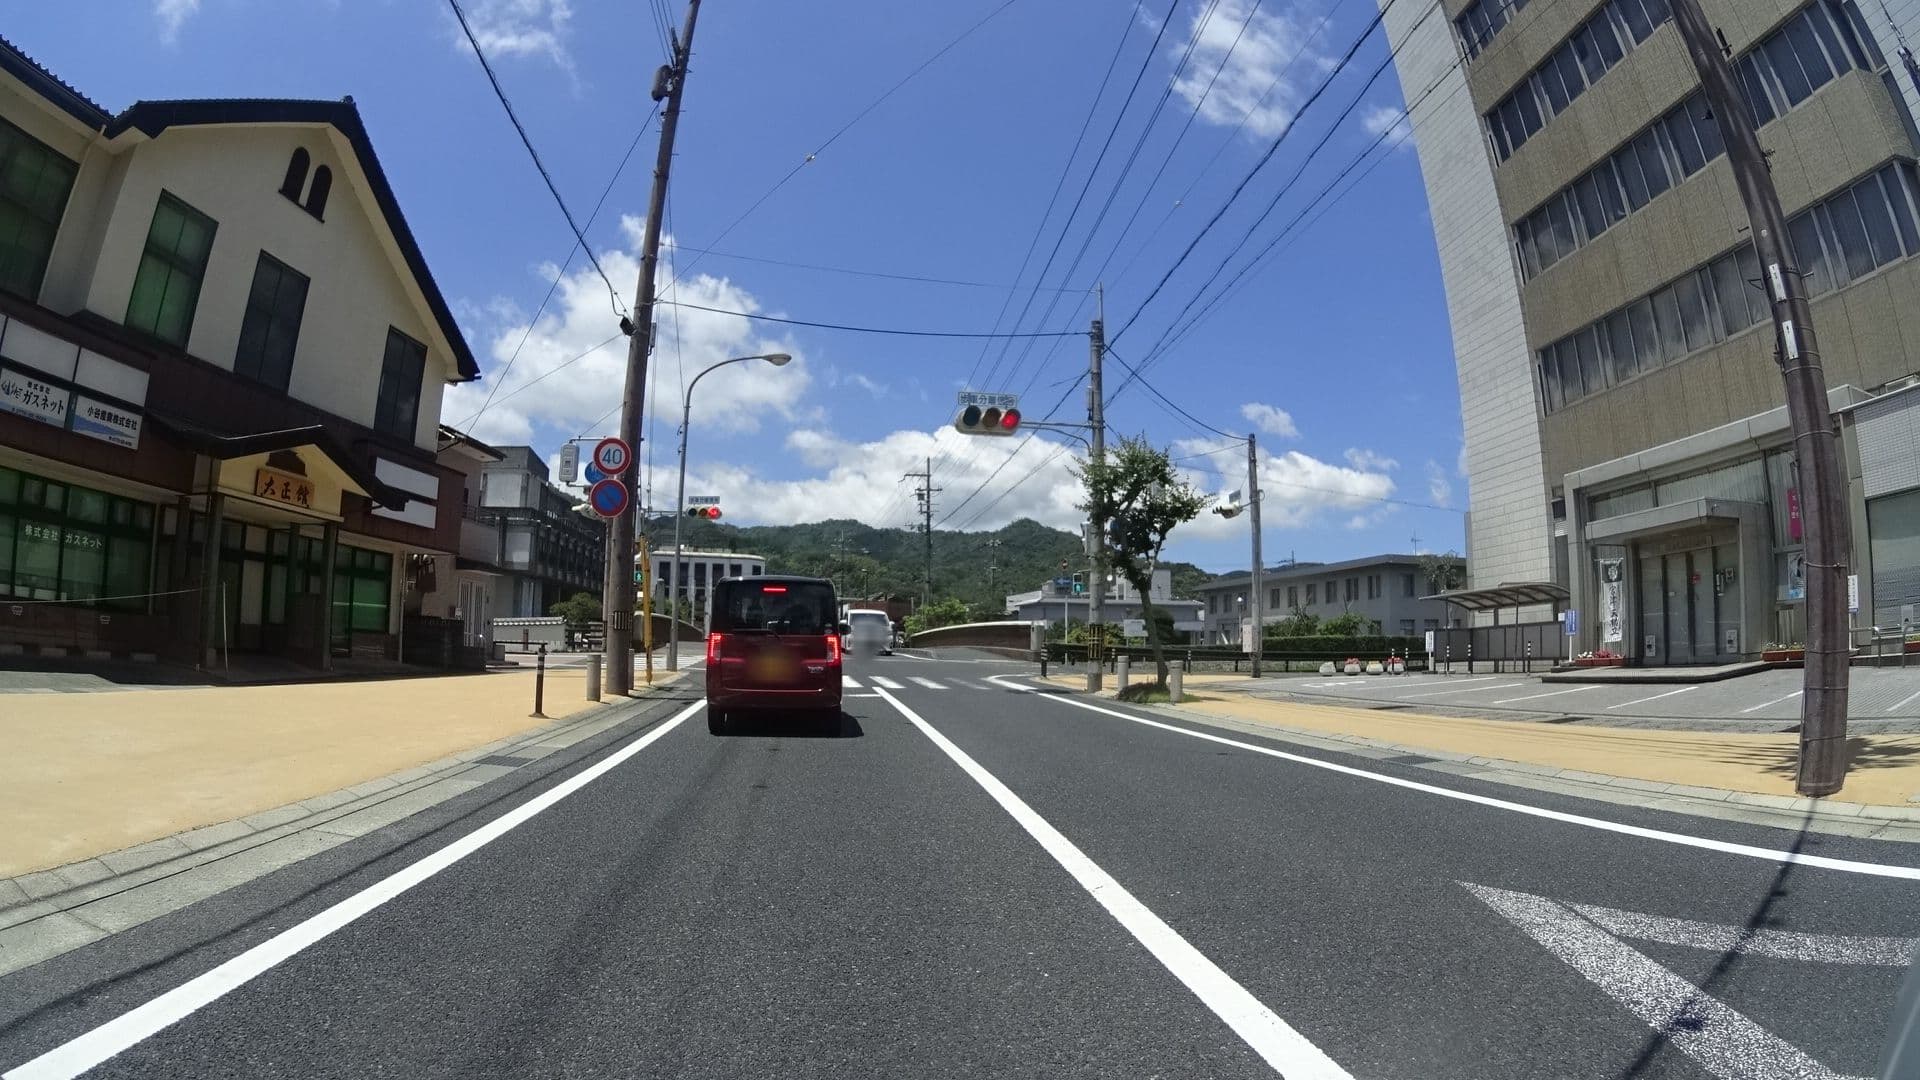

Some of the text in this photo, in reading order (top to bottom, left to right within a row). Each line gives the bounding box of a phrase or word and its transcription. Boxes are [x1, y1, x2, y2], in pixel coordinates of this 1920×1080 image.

[23, 390, 64, 414] ガスネット
[602, 448, 622, 464] 40
[65, 533, 102, 549] ガスネット
